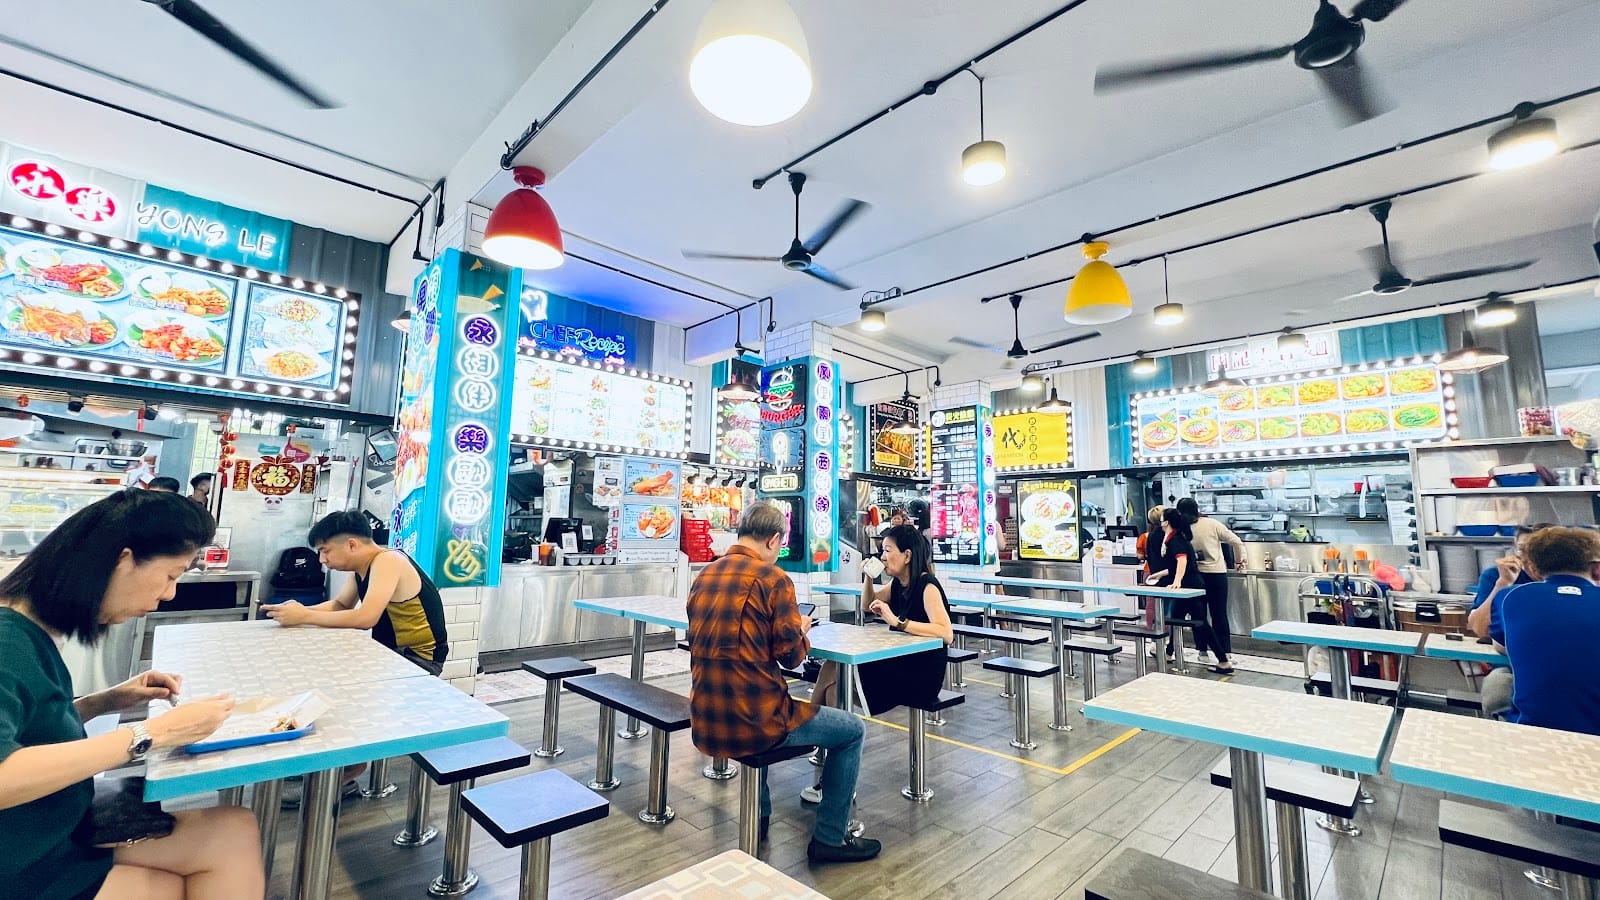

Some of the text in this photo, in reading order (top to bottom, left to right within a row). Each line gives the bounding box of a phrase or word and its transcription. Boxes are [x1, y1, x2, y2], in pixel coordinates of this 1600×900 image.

[136, 201, 277, 258] YONG LE
[530, 322, 575, 344] CHEF
[573, 328, 626, 356] Recipe
[761, 404, 803, 423] BURGER
[262, 465, 291, 488] 福
